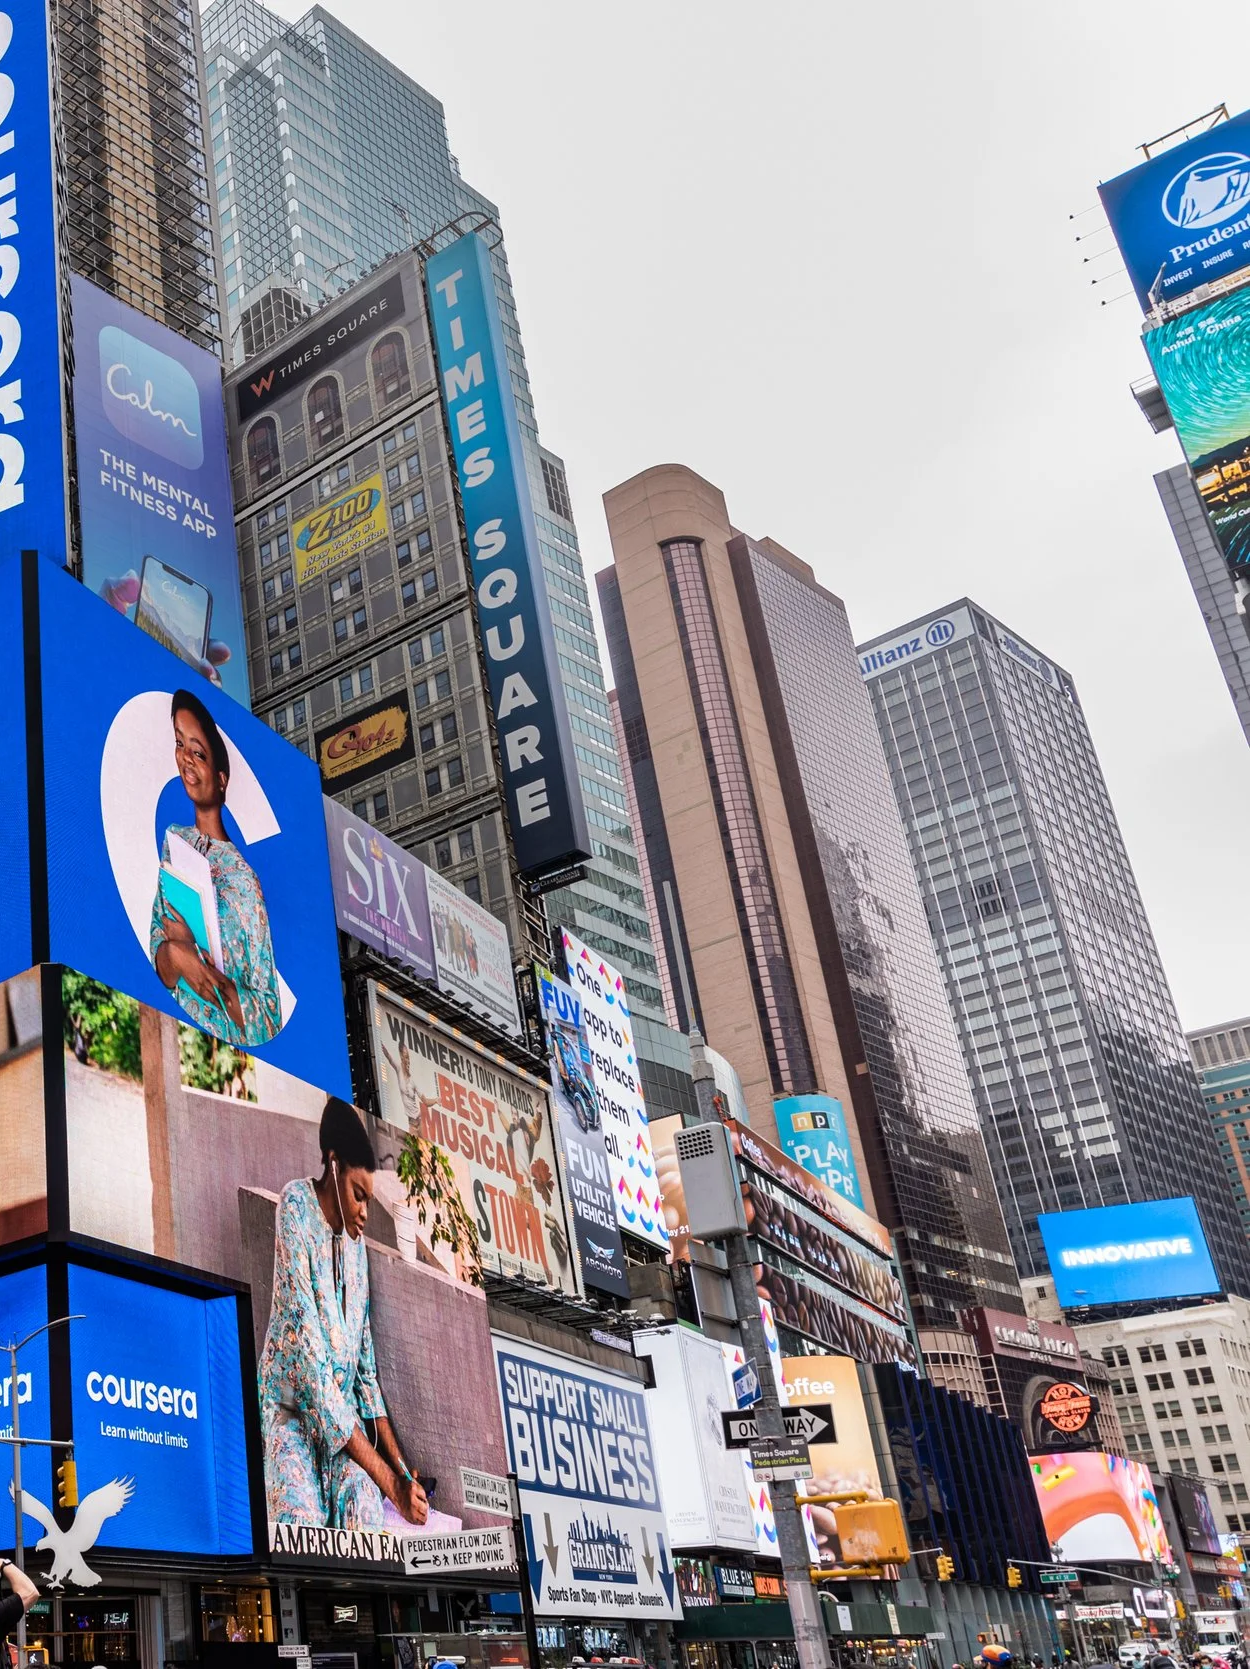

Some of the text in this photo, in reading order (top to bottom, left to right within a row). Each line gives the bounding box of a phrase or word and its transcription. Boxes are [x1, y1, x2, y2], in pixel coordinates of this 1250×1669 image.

[1163, 249, 1234, 287] INVEST INSURE
[1206, 314, 1243, 335] China
[250, 298, 389, 398] W TIMES SQUARE
[106, 363, 197, 437] Calm
[99, 448, 215, 521] THE MENTAL
[100, 470, 217, 540] FITNESS APP
[306, 488, 373, 552] Z100
[301, 528, 385, 580] Hit Music Station
[306, 520, 376, 566] New York's #1
[435, 269, 495, 489] TIMES
[475, 518, 551, 828] SQUARE
[343, 827, 423, 941] SIX
[576, 962, 602, 998] One
[540, 977, 581, 1029] FUV
[583, 1008, 623, 1048] app to
[386, 1012, 534, 1117] WINNER! 8 TONY AWARDS
[591, 1049, 636, 1093] replace
[437, 1072, 496, 1134] BEST
[596, 1085, 631, 1127] them
[794, 1113, 838, 1130] npr
[419, 1102, 524, 1185] MUSICAL
[604, 1132, 623, 1161] all.
[565, 1137, 609, 1189] FUN
[571, 1176, 612, 1211] UTILITY
[573, 1198, 617, 1233] VEHICLE
[680, 1224, 690, 1234] 21
[585, 1256, 623, 1280] ARCIMOTO
[1062, 1237, 1193, 1266] INNOVATIVE
[86, 1371, 198, 1420] coursera
[503, 1360, 646, 1437] SUPPORT SMALL
[1051, 1387, 1073, 1401] HOT
[100, 1421, 189, 1449] Learn without limits
[738, 1417, 816, 1437] ON WAY
[509, 1407, 657, 1504] BUSINESS
[752, 1448, 800, 1458] Times Square
[789, 1456, 808, 1464] Plaza
[272, 1523, 375, 1561] AMERICAN
[407, 1533, 502, 1552] PEDESTRIAN FLOW ZONE
[453, 1549, 505, 1565] KEEP MOVING
[720, 1567, 740, 1585] BLUE
[547, 1586, 664, 1607] Sports Fan Shop NYC Apparel Souvenirs
[1203, 1617, 1227, 1625] FedEx
